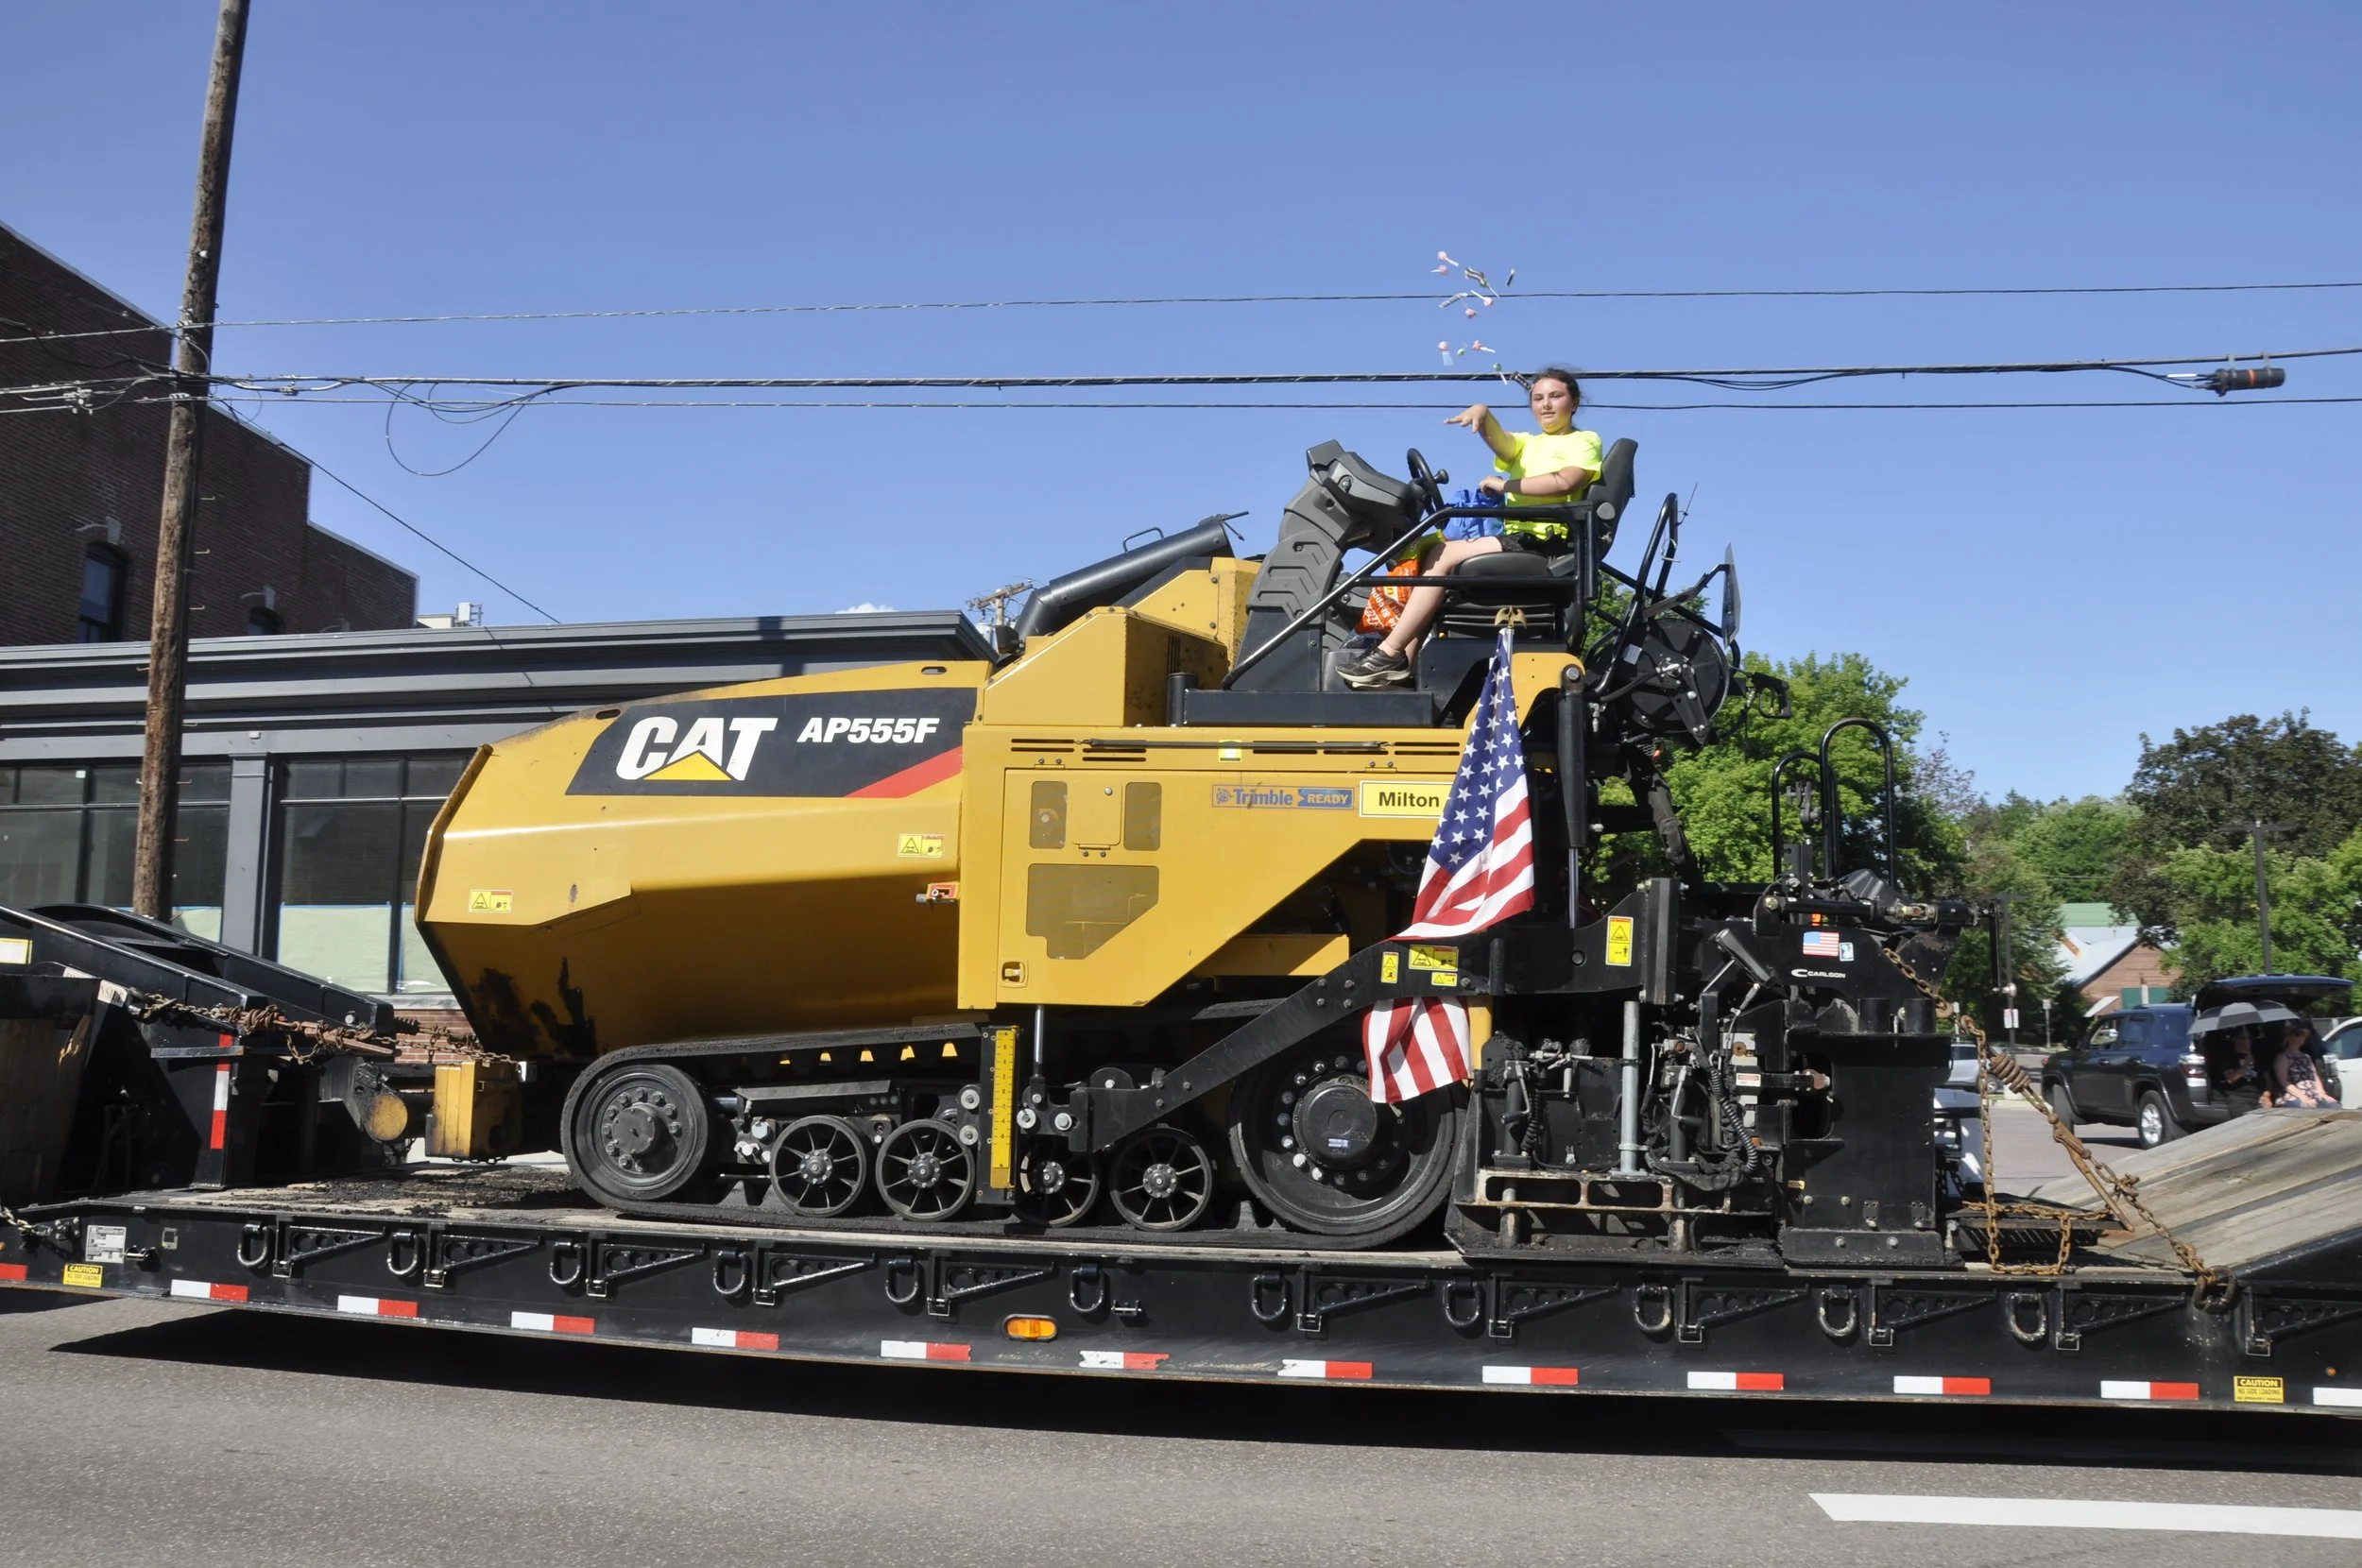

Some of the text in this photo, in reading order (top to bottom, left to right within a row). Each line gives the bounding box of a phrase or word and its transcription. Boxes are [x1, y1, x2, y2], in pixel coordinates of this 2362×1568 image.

[796, 717, 940, 743] AP555F
[615, 716, 779, 781] CAT
[1233, 788, 1349, 806] Trimble READY
[1378, 792, 1440, 808] Milton
[1806, 970, 1846, 979] CARLSON
[69, 1266, 99, 1274] CAUTION
[2239, 1378, 2279, 1388] CAUTION
